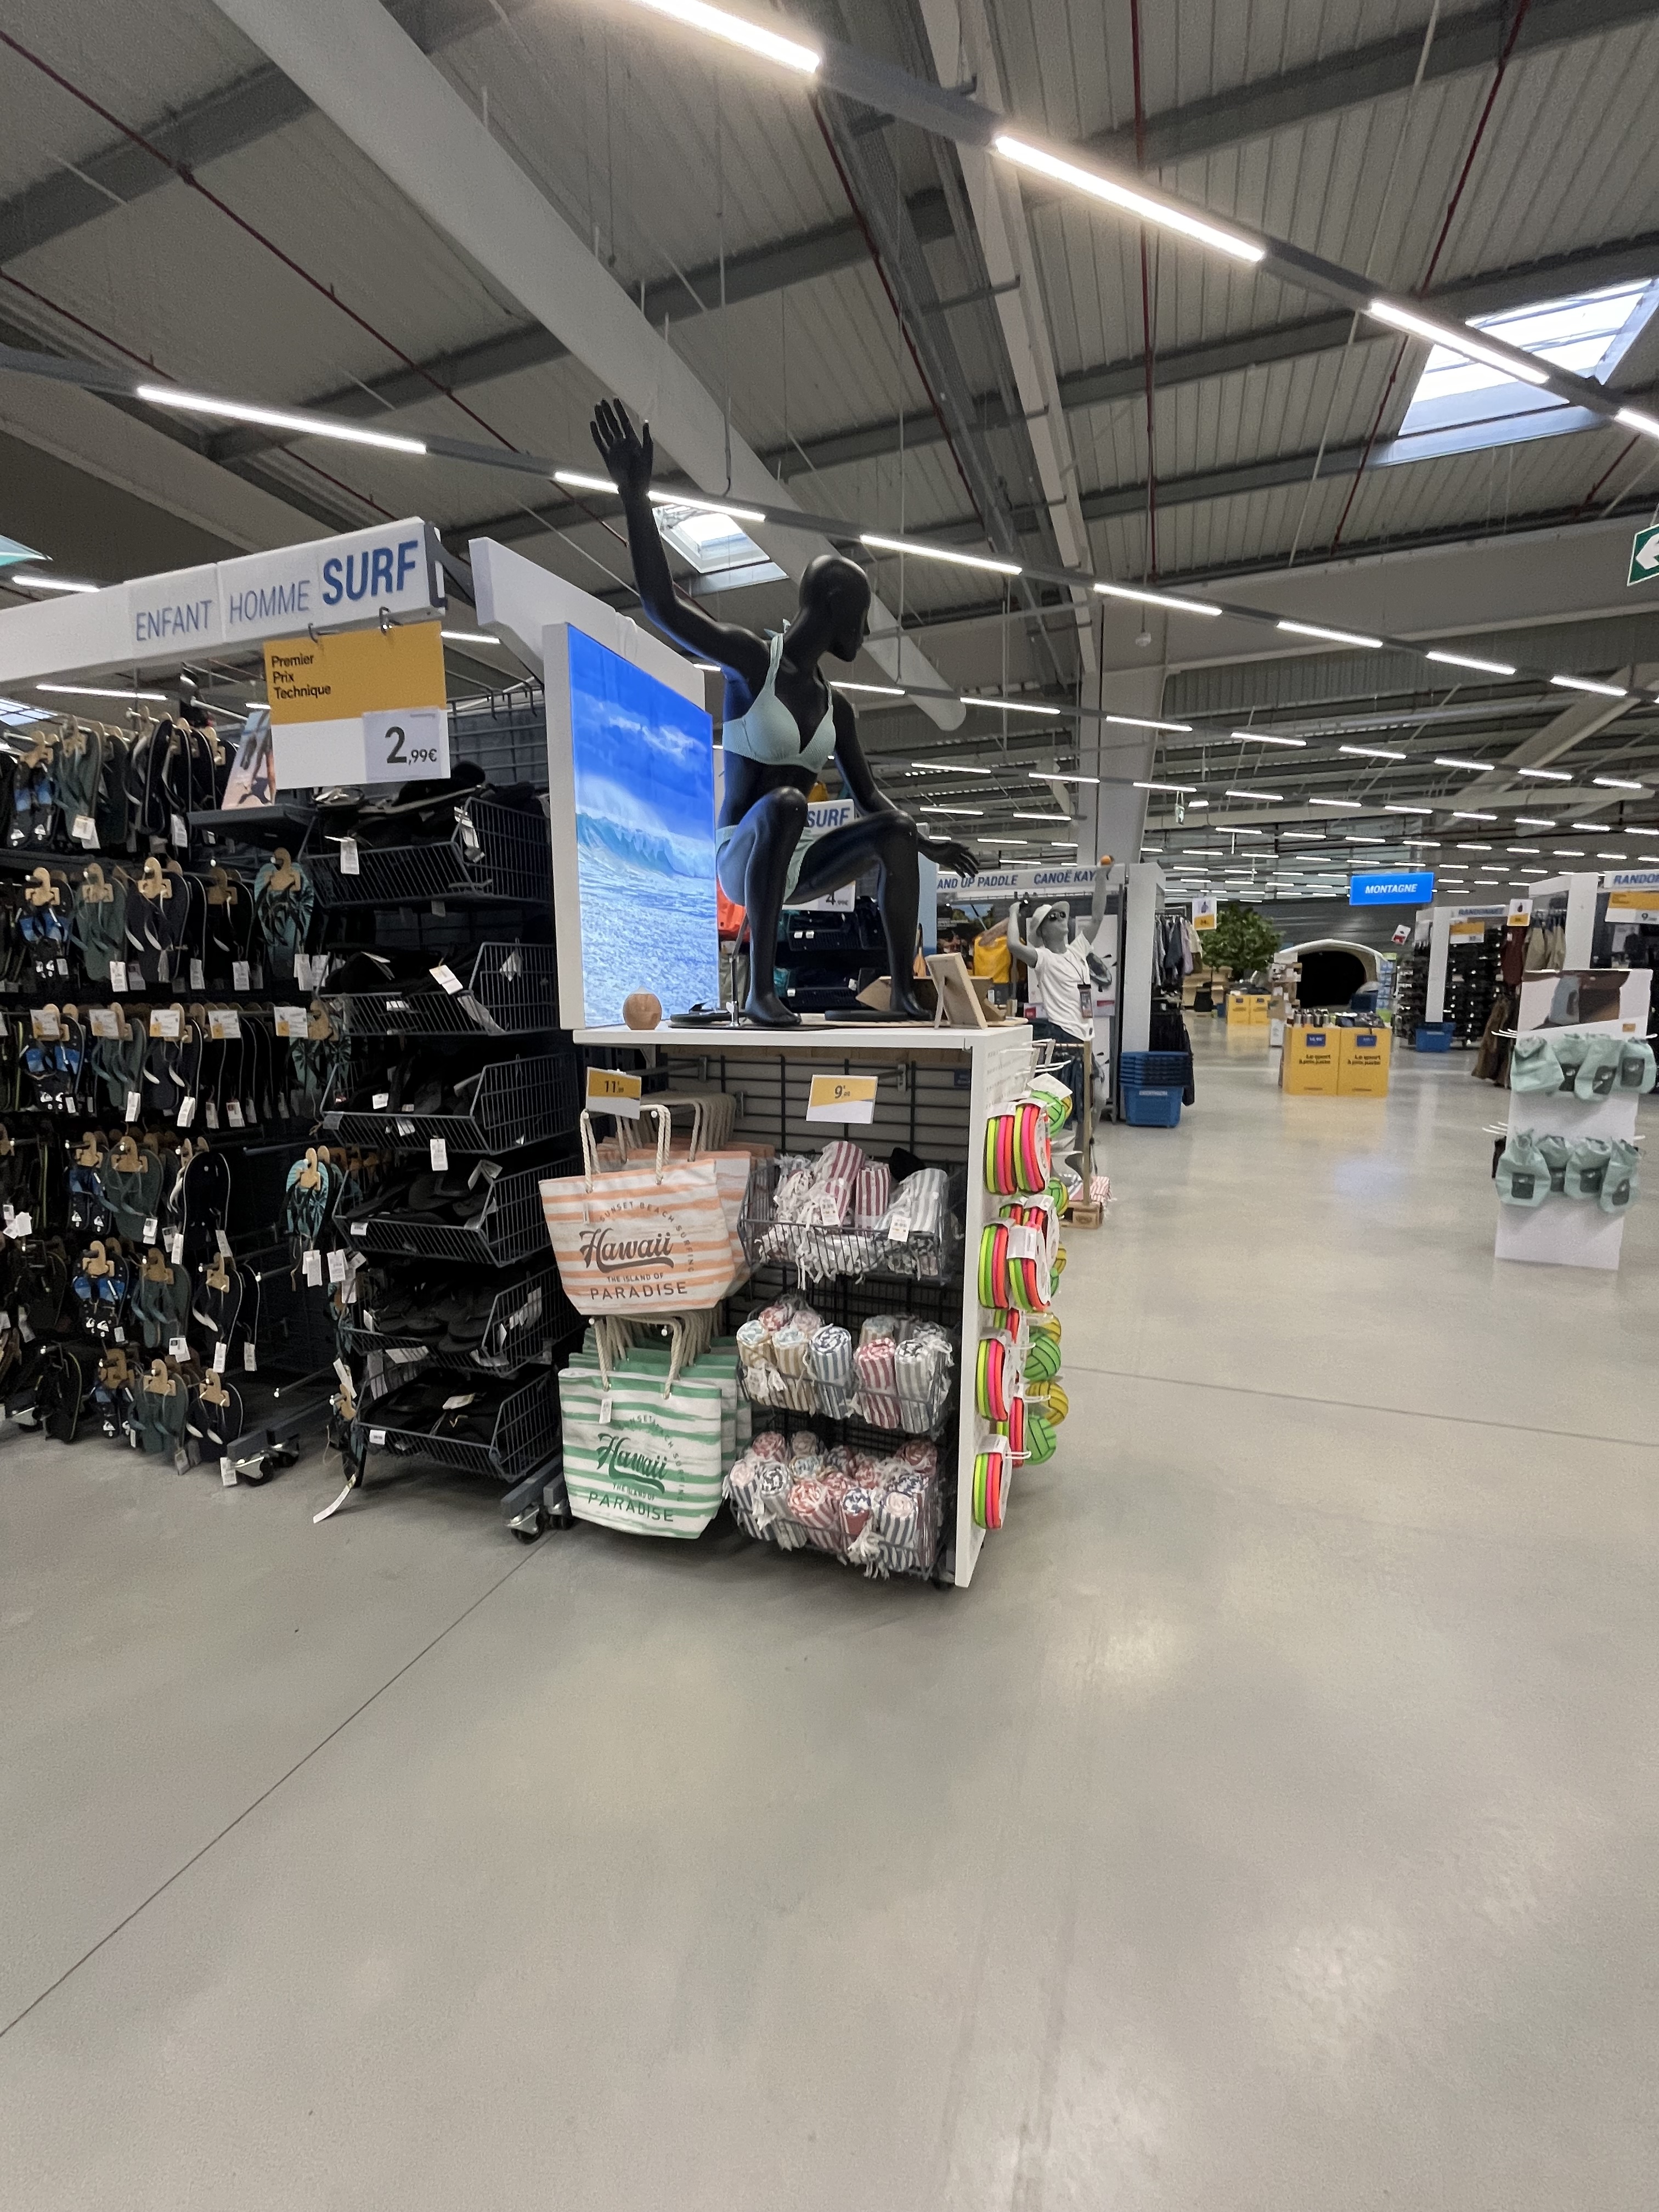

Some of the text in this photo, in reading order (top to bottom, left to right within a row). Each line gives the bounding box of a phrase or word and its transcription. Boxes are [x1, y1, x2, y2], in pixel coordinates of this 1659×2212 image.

[136, 540, 419, 642] ENFANT HOMME SURF
[271, 653, 314, 668] Premier
[272, 670, 295, 684] Prix
[274, 684, 331, 699] Technique
[385, 726, 437, 766] 2,99€
[807, 807, 850, 828] SURF
[936, 878, 958, 890] AND
[960, 877, 975, 888] UP
[977, 874, 1019, 887] PADDLE
[1074, 870, 1109, 882] KAY
[1365, 883, 1418, 894] MONTAGNE
[599, 1201, 634, 1223] SUNSET
[640, 1201, 675, 1223] BEACH
[579, 1227, 674, 1274] Hawaii
[623, 1274, 651, 1283] ISLAND
[590, 1281, 688, 1301] PARADISE
[596, 1432, 667, 1494] Hawaii
[588, 1491, 674, 1522] PARADISE
